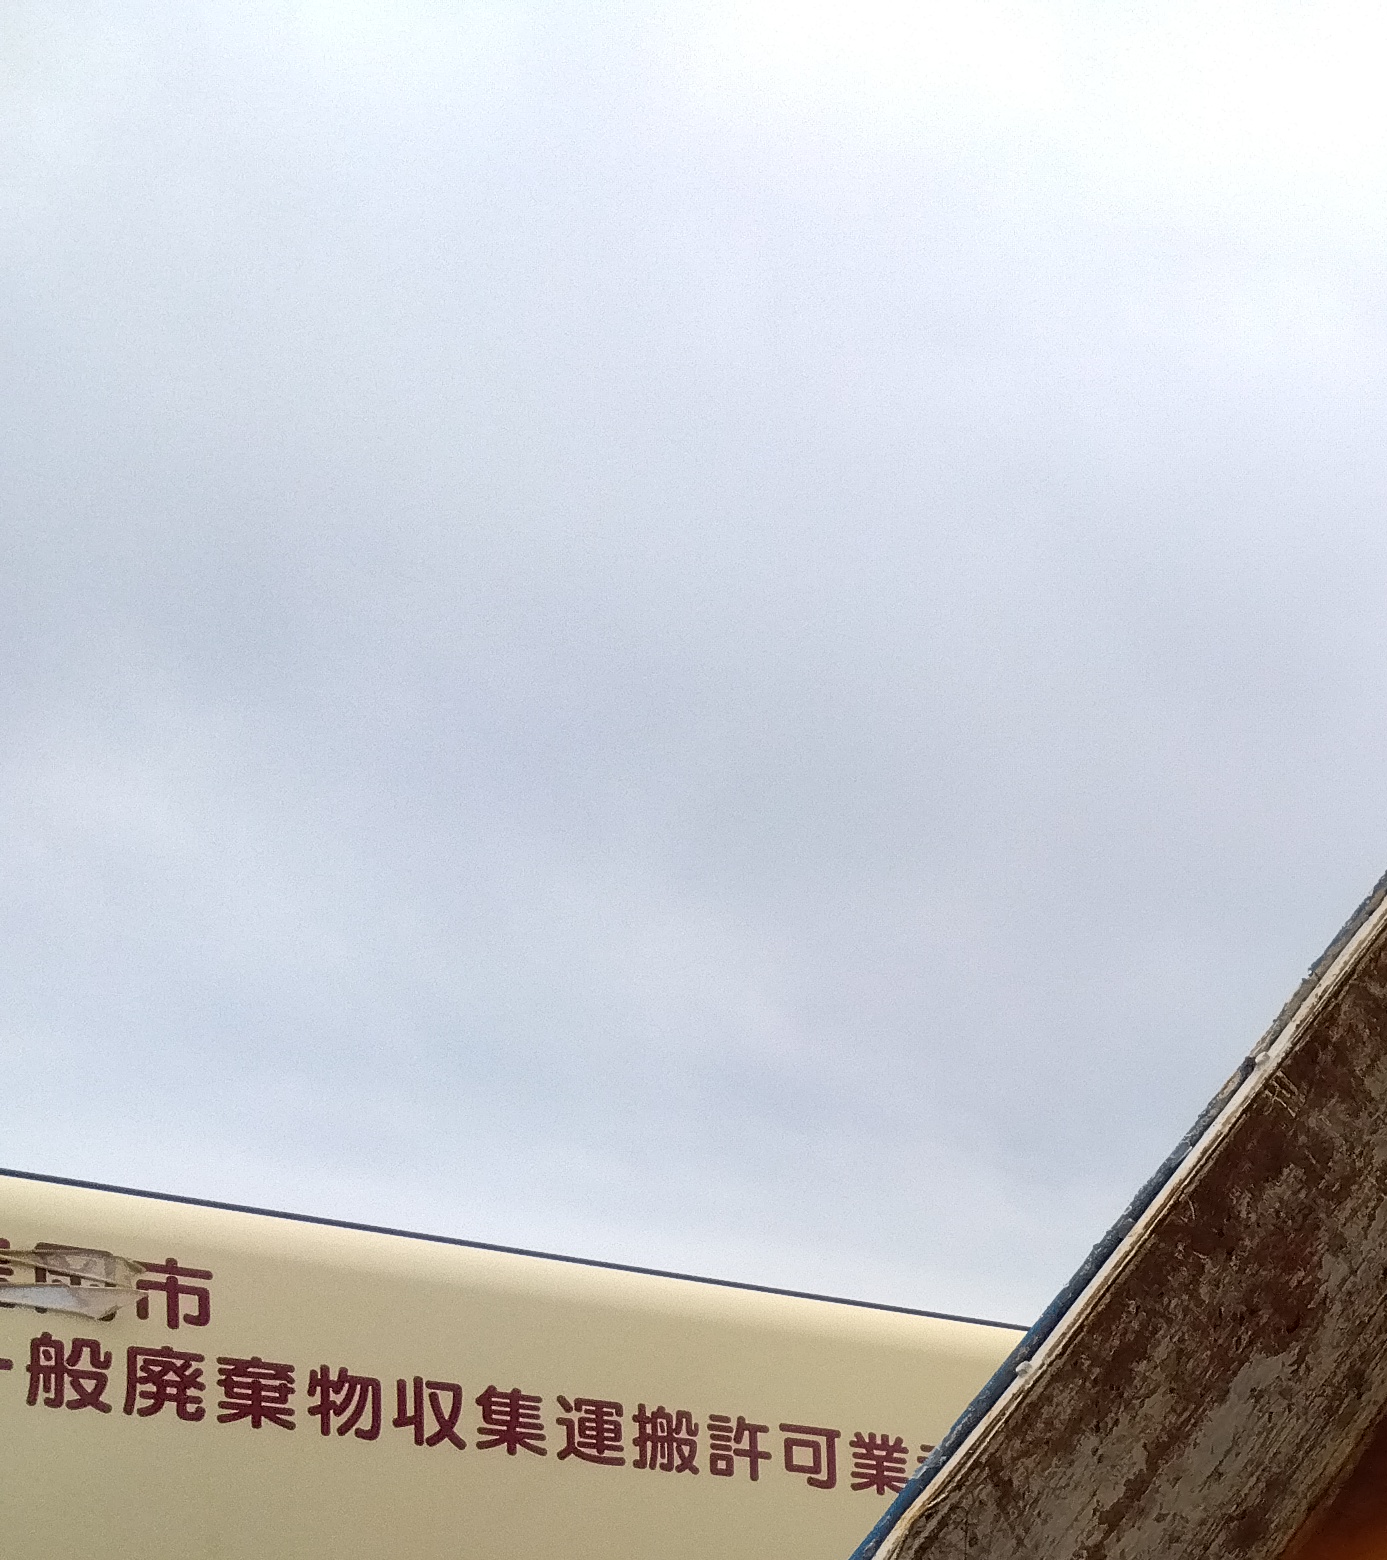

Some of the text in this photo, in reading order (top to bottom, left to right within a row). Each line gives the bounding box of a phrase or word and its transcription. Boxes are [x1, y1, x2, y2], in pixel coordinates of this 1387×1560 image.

[0, 1331, 936, 1496] 般廃棄物収集運搬許可業
